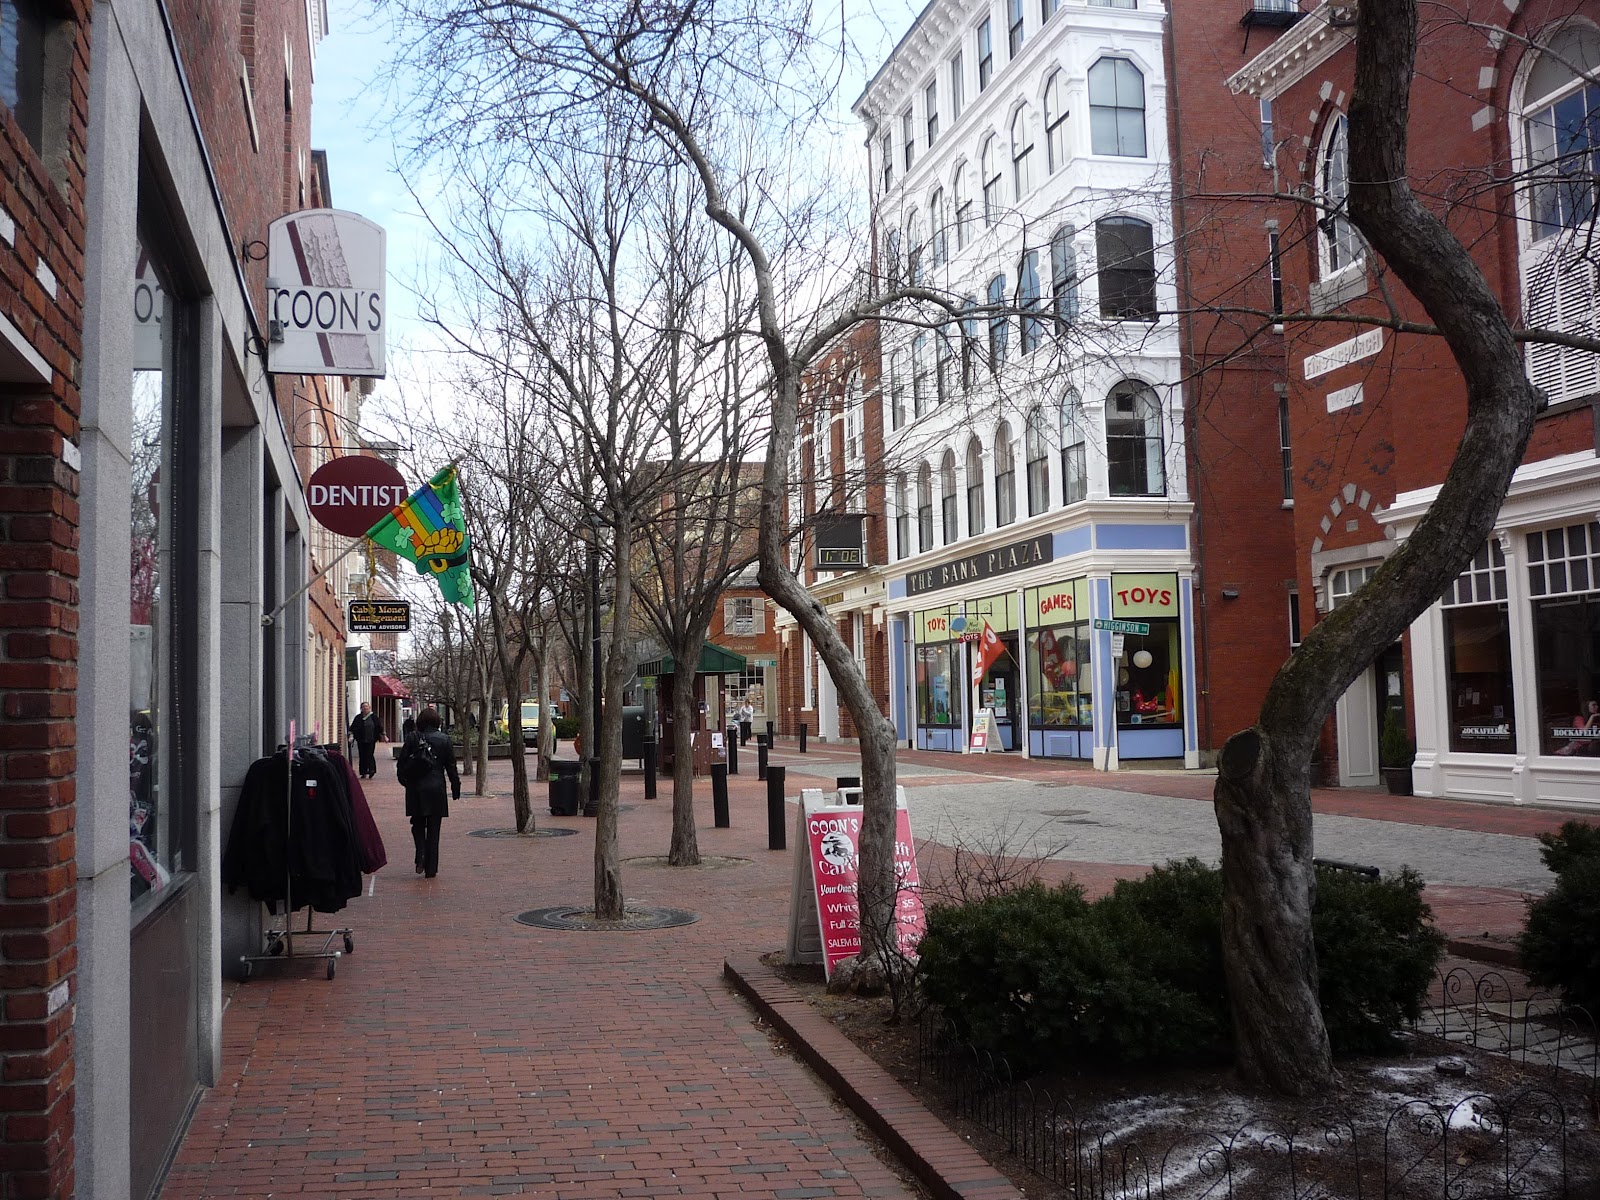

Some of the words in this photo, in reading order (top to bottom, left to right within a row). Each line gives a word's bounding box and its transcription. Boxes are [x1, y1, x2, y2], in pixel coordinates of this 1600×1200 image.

[274, 289, 382, 331] COON'S
[310, 484, 405, 506] DENTIST
[910, 571, 934, 592] THE
[942, 558, 979, 584] BANK
[988, 541, 1043, 572] PLAZA
[1117, 588, 1172, 606] TOYS
[351, 606, 377, 614] Cabt
[378, 606, 407, 615] Money
[1040, 594, 1073, 615] GAMES
[352, 614, 407, 623] Mangement
[927, 617, 947, 633] TOYS
[1103, 621, 1140, 632] HIGGINSON
[961, 633, 979, 642] TOYS
[810, 818, 859, 836] COON'S
[820, 884, 837, 897] Your
[901, 899, 915, 909] $5
[828, 939, 852, 949] SALEM
